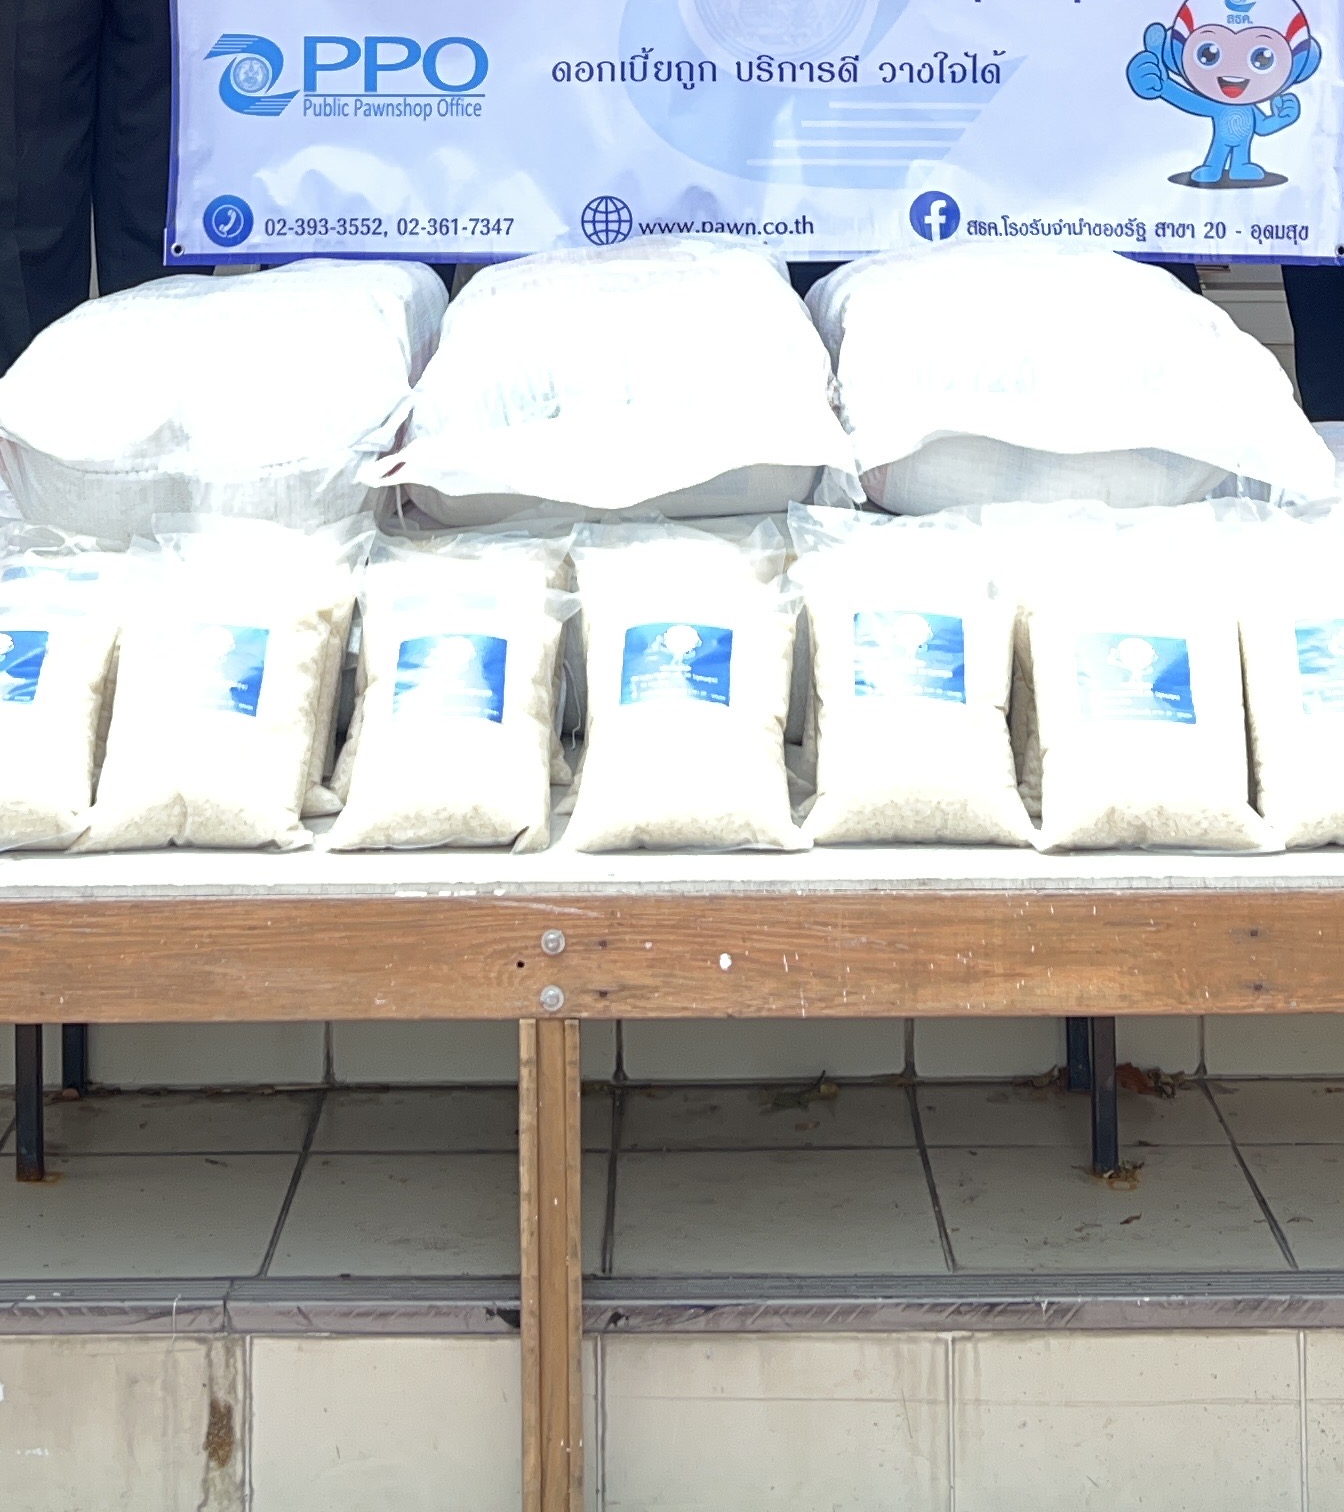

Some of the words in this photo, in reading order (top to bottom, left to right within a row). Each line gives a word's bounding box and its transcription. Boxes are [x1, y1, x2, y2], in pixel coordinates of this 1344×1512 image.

[302, 35, 489, 93] PPO
[551, 46, 717, 90] ดอกเบี้ยถูก
[735, 54, 860, 84] บริการดี
[878, 49, 1007, 85] วางใจได้
[302, 97, 350, 118] Public
[353, 97, 433, 122] Pawnshop
[436, 97, 483, 118] Office
[264, 217, 389, 238] 02-393-3552,
[396, 217, 515, 237] 02-361-7347
[1154, 221, 1196, 240] สาขา
[1203, 221, 1227, 240] 20
[1250, 223, 1309, 246] อุดมสุข
